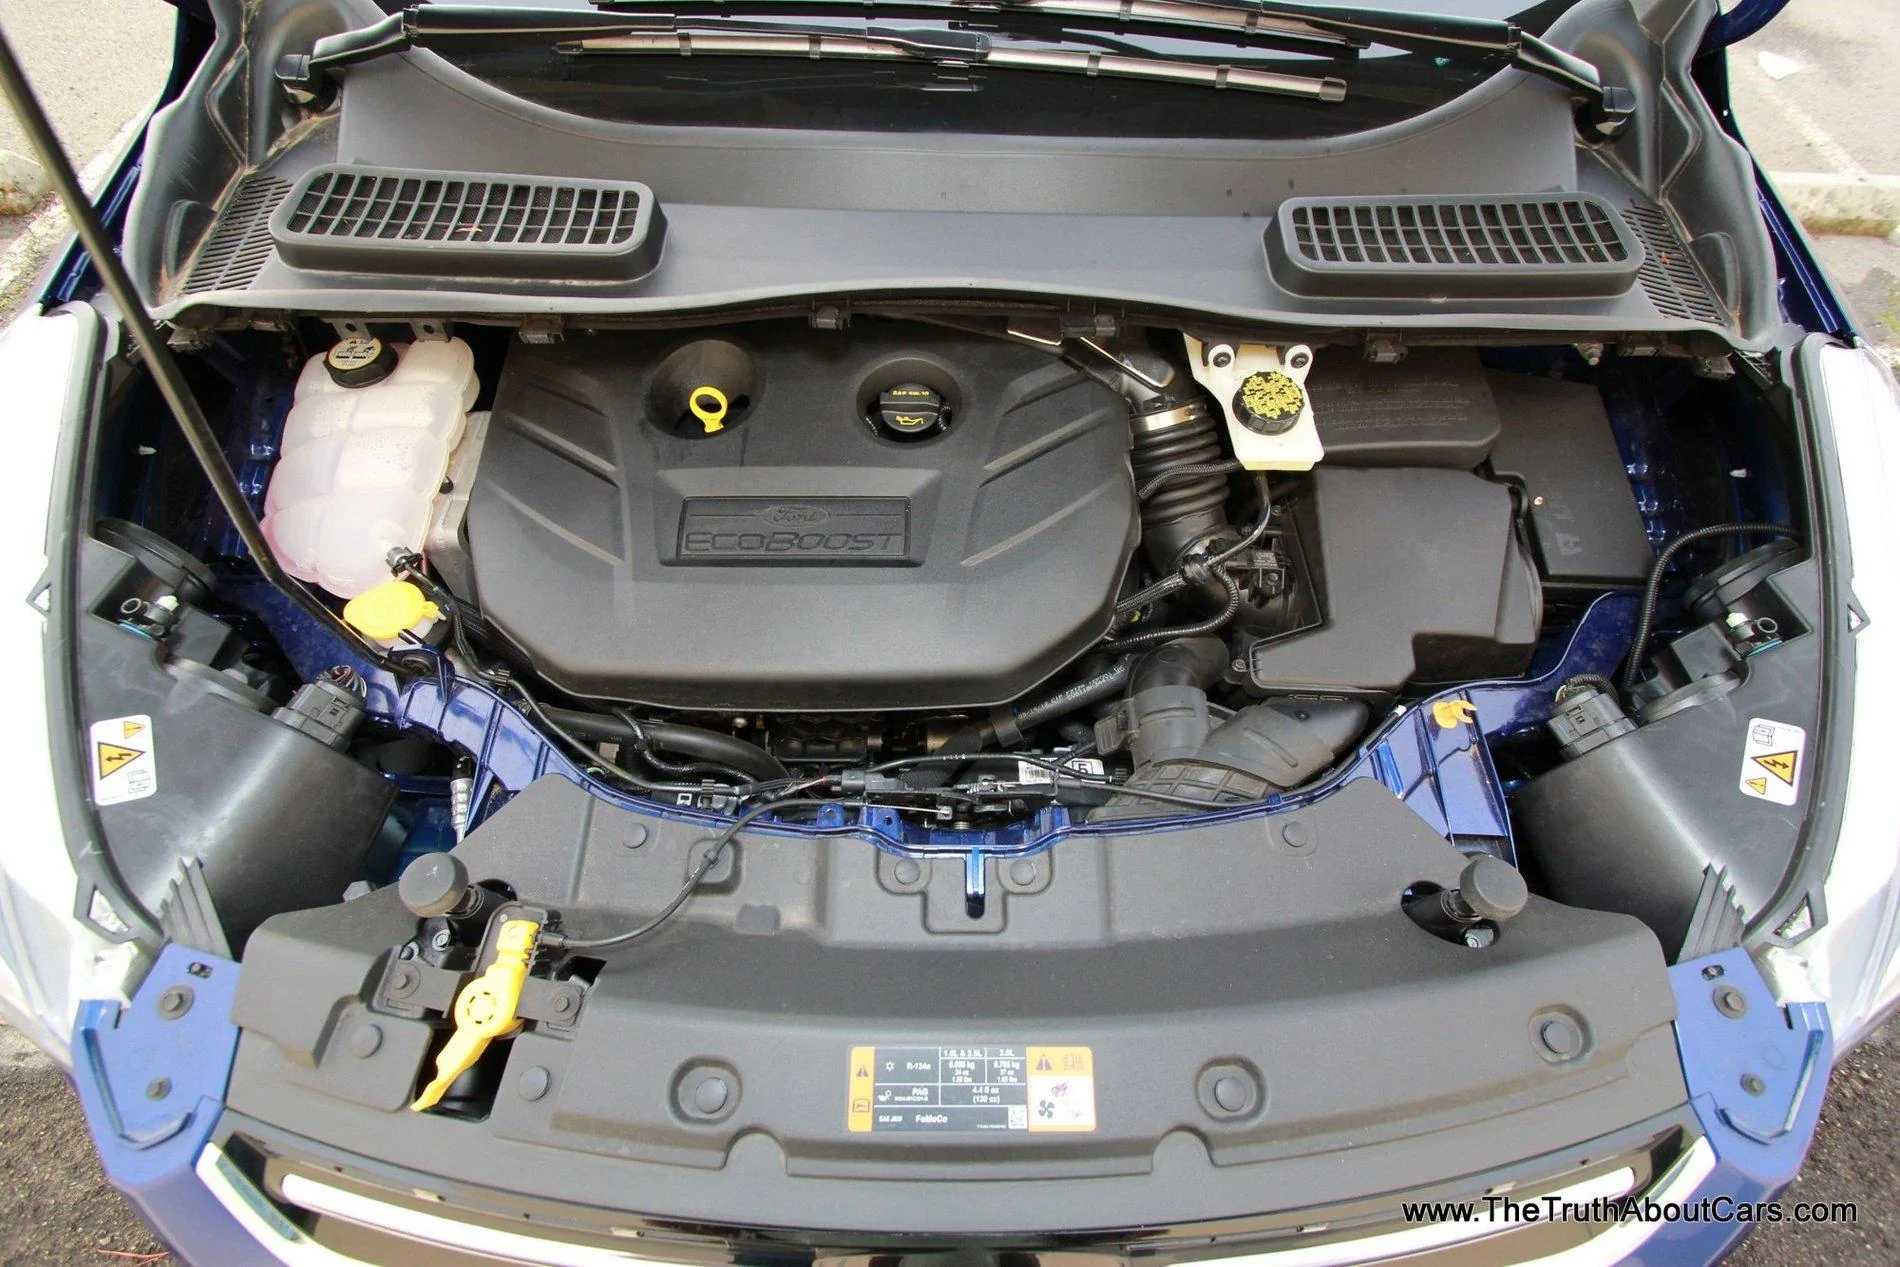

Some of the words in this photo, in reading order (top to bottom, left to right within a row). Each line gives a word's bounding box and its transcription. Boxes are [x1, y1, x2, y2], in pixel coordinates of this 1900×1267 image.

[772, 506, 819, 523] Ford
[906, 1062, 931, 1070] R-134a
[912, 1087, 929, 1096] PAG
[915, 1114, 948, 1123] FoMoCo
